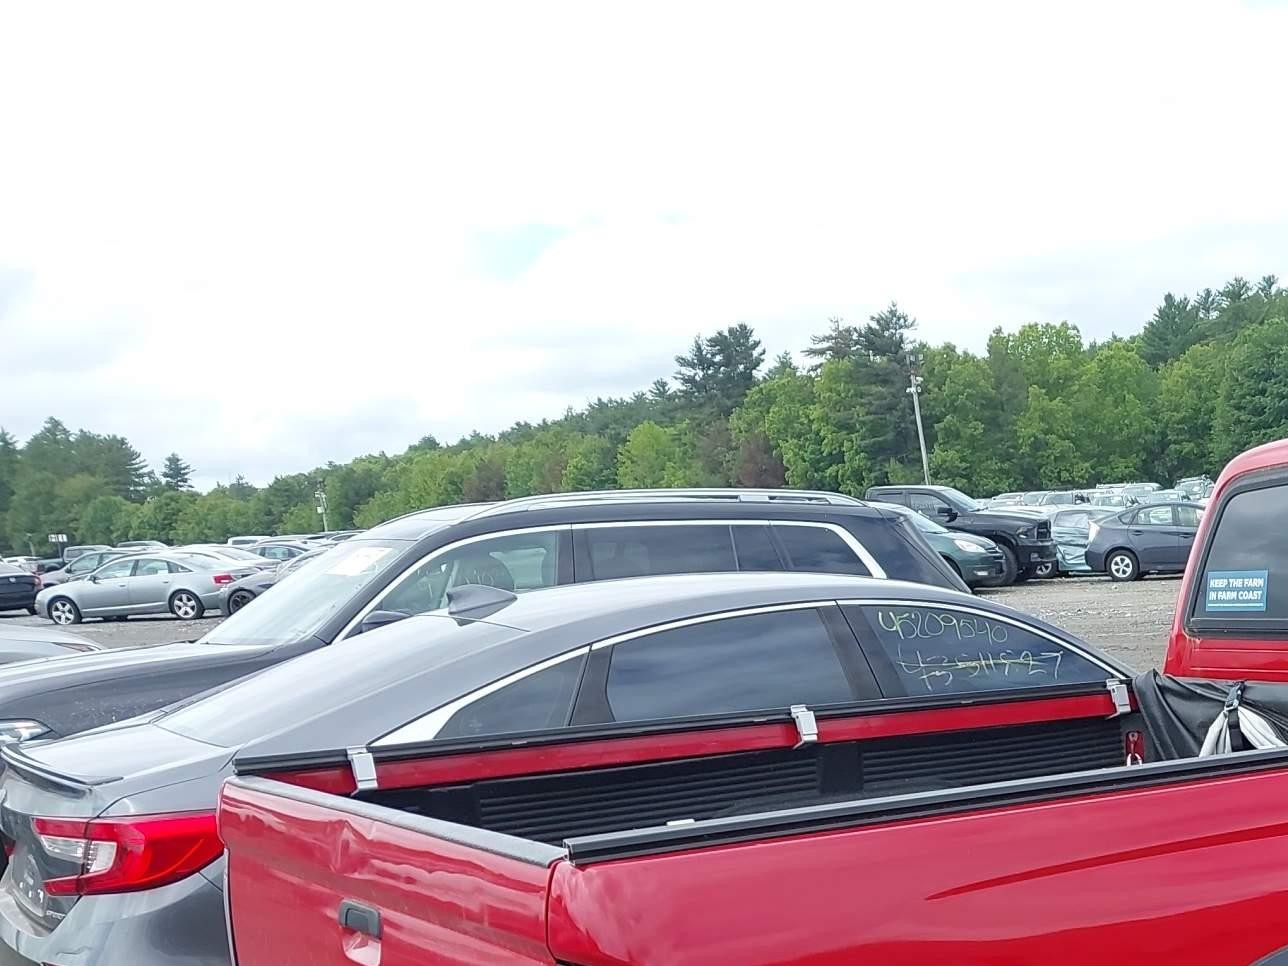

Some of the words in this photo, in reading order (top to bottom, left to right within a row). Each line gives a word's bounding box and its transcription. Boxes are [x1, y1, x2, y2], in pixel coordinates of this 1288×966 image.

[1209, 578, 1228, 588] KEEP
[1229, 578, 1243, 588] THE
[1243, 577, 1265, 588] FARM
[1208, 590, 1217, 600] IN
[1217, 590, 1238, 600] FARM
[1238, 590, 1262, 600] COAST
